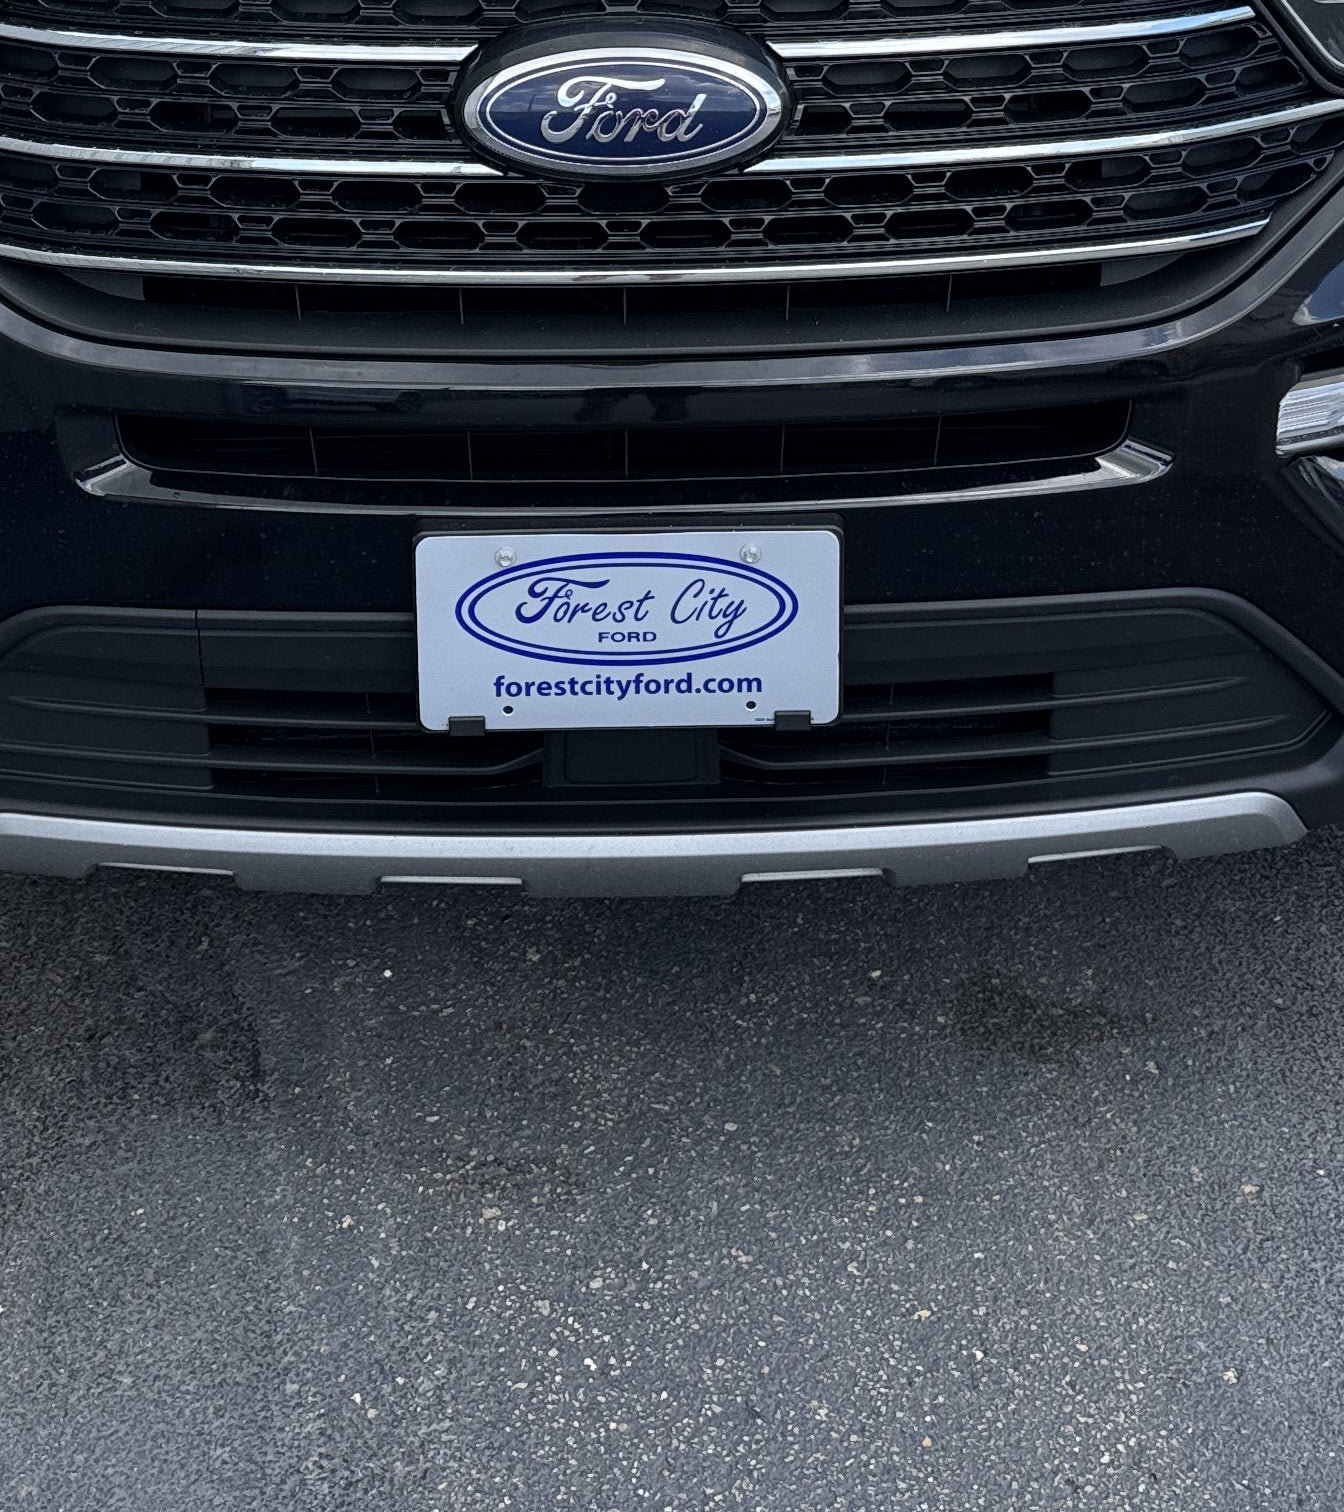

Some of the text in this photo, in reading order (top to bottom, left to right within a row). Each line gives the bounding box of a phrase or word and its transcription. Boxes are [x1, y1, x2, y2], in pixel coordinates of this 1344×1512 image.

[541, 76, 707, 142] Ford
[515, 577, 747, 639] Forest City
[598, 631, 657, 643] FORD
[493, 672, 762, 701] forestcityford.com
